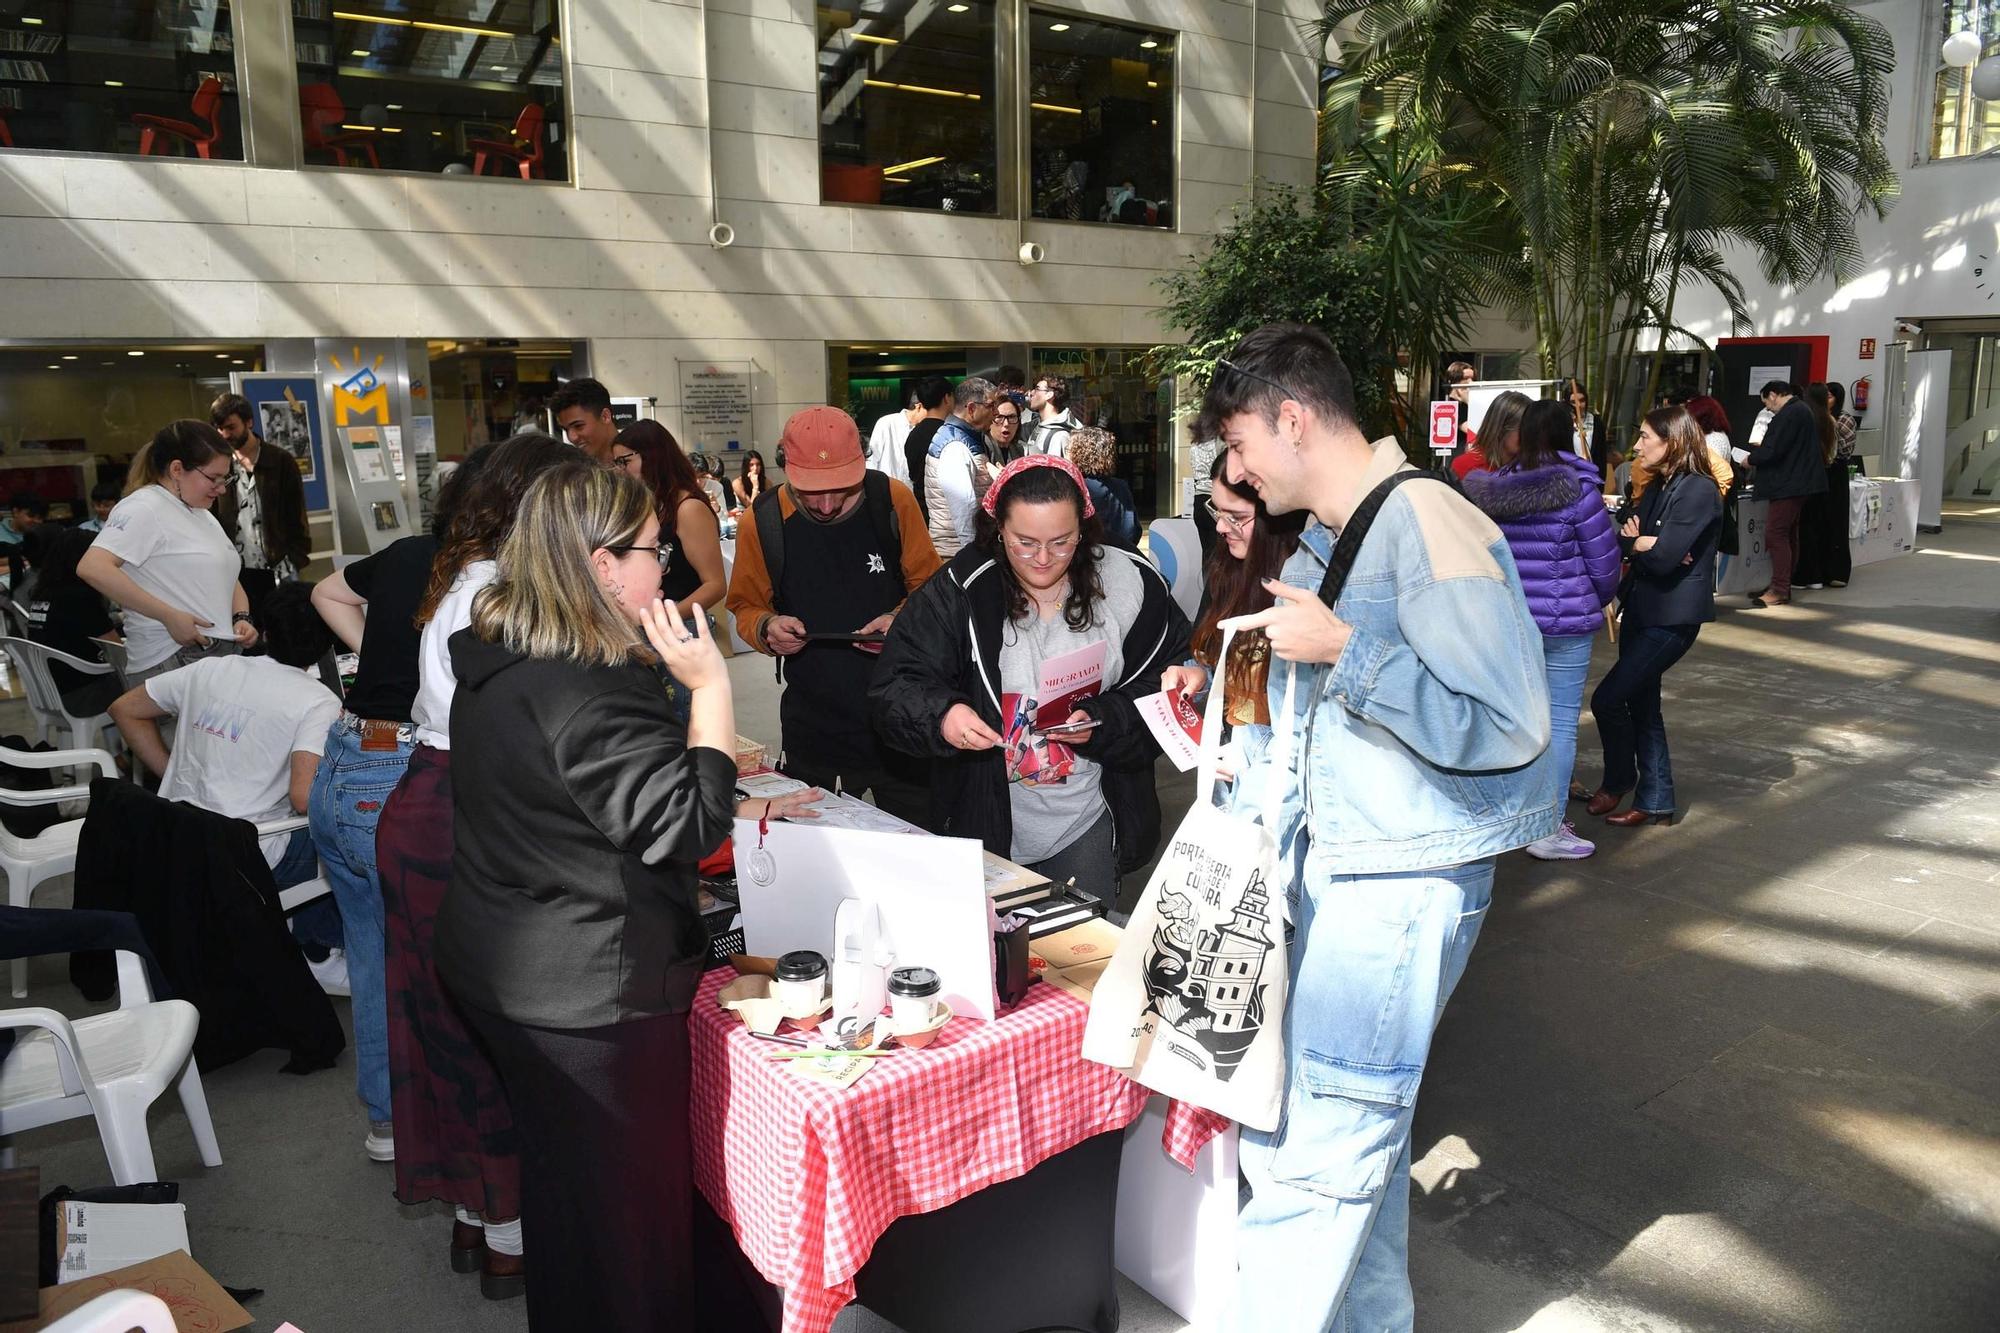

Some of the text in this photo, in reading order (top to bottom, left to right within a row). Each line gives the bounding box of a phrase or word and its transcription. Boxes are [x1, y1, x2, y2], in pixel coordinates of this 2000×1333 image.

[1974, 268, 1983, 277] 9
[415, 452, 434, 536] INFANTIL
[1173, 841, 1205, 862] PORTA
[1186, 870, 1221, 911] CUURA
